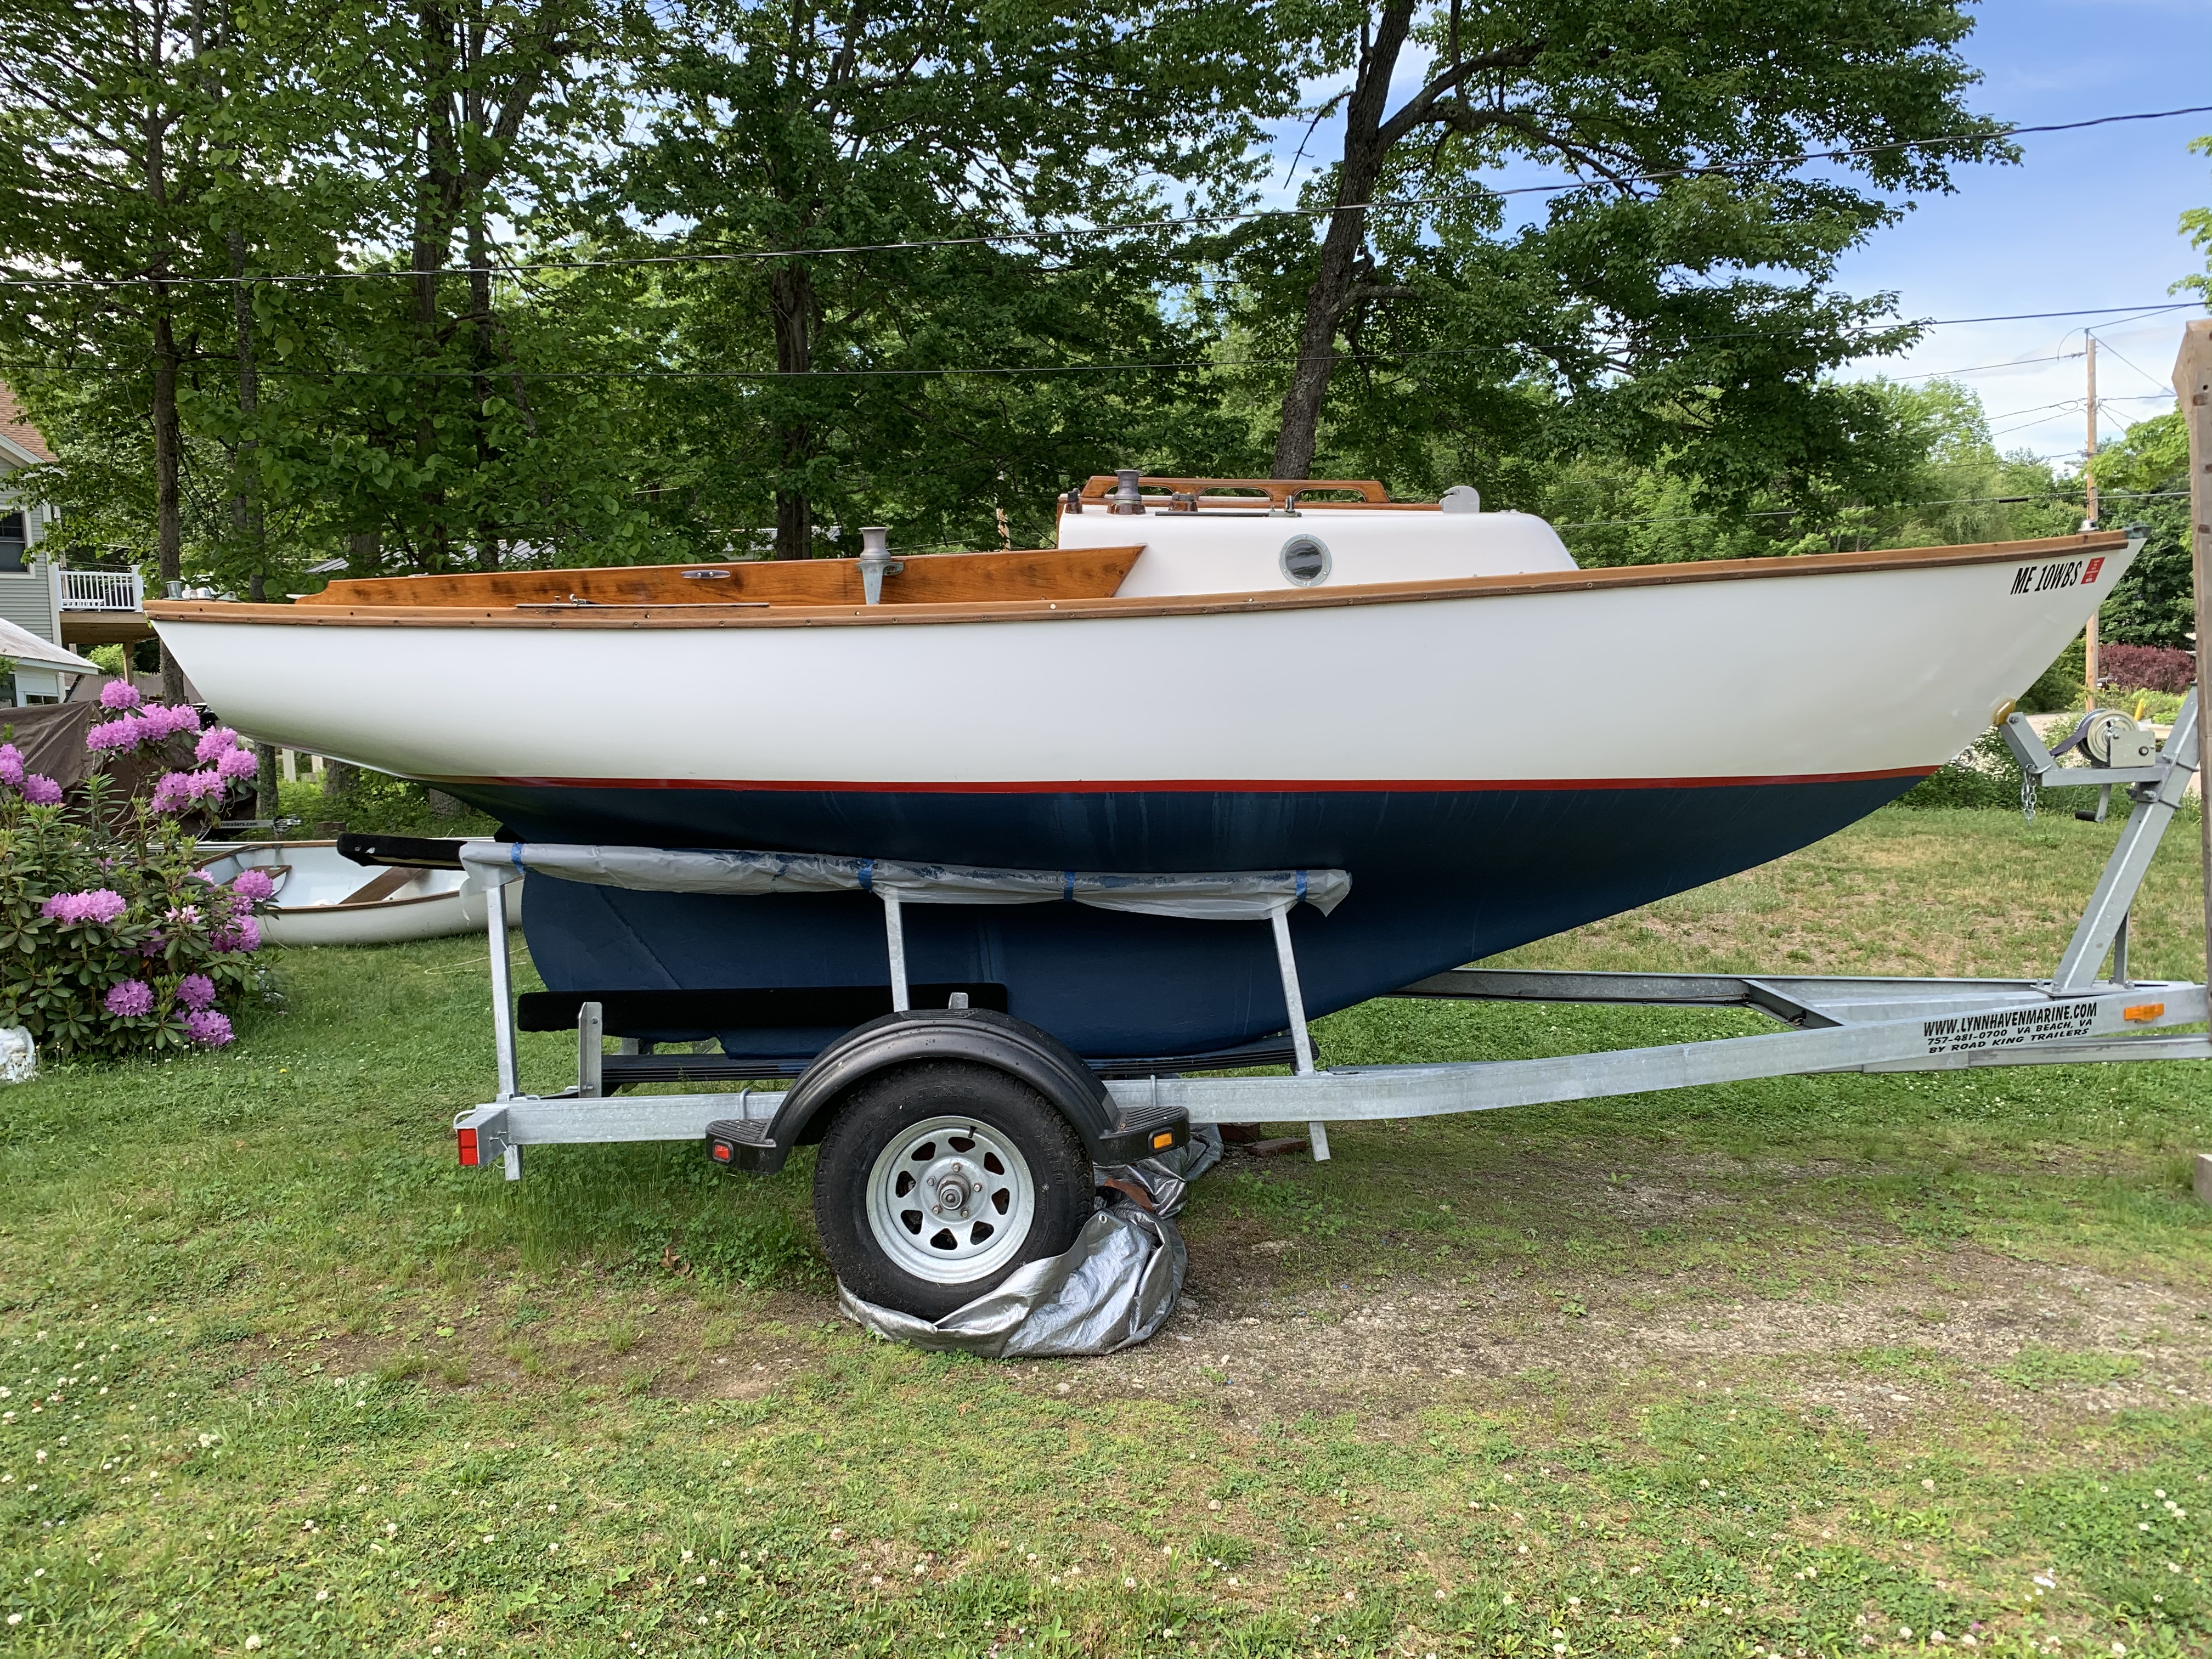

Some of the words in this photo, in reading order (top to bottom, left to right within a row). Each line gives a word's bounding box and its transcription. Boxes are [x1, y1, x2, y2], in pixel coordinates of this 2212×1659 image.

[2010, 566, 2037, 595] ME
[2034, 561, 2083, 592] 10WBS
[1924, 1002, 2097, 1037] WWW.LYNNHAVENMARINE.COM
[1928, 1029, 2007, 1045] 757-481-0700
[2036, 1021, 2073, 1032] BEACH,
[1951, 1041, 1986, 1051] ROAD
[1992, 1036, 2024, 1046] KING
[2030, 1028, 2090, 1041] TRAILERS
